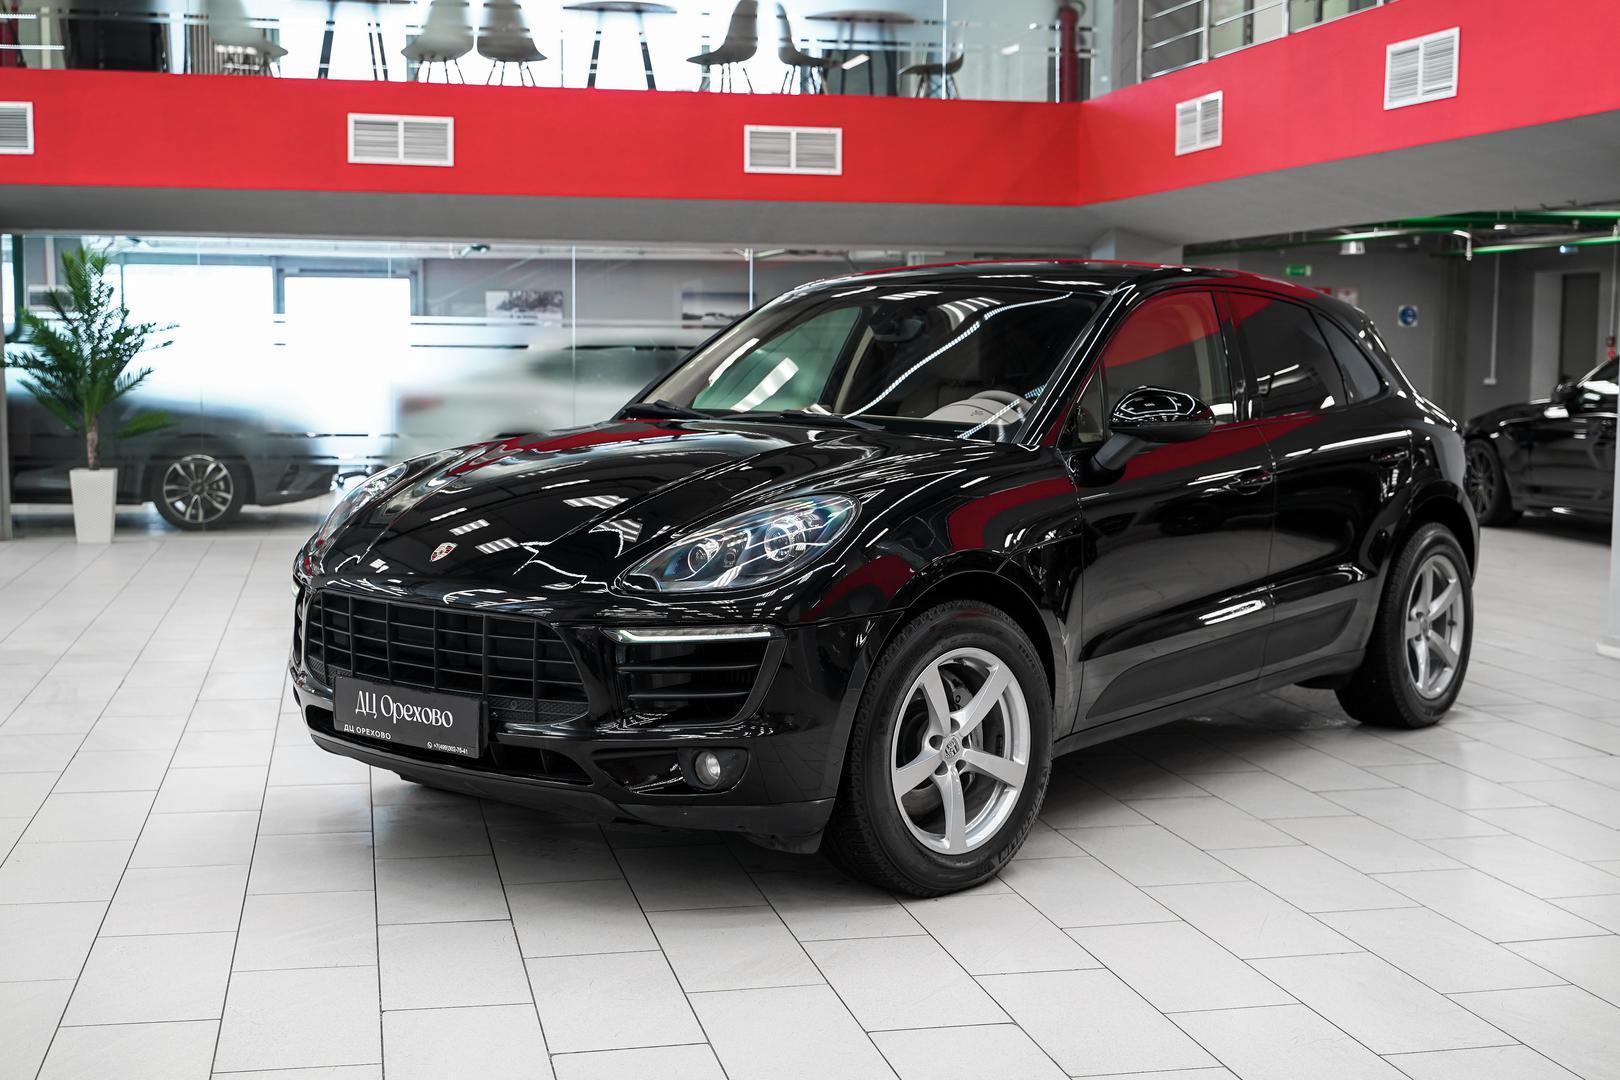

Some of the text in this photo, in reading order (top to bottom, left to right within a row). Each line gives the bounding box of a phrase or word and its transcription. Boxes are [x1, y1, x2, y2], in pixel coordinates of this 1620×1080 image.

[355, 690, 454, 728] ДЦ Орехово
[343, 723, 391, 740] ДЦ ОРЕХОВО
